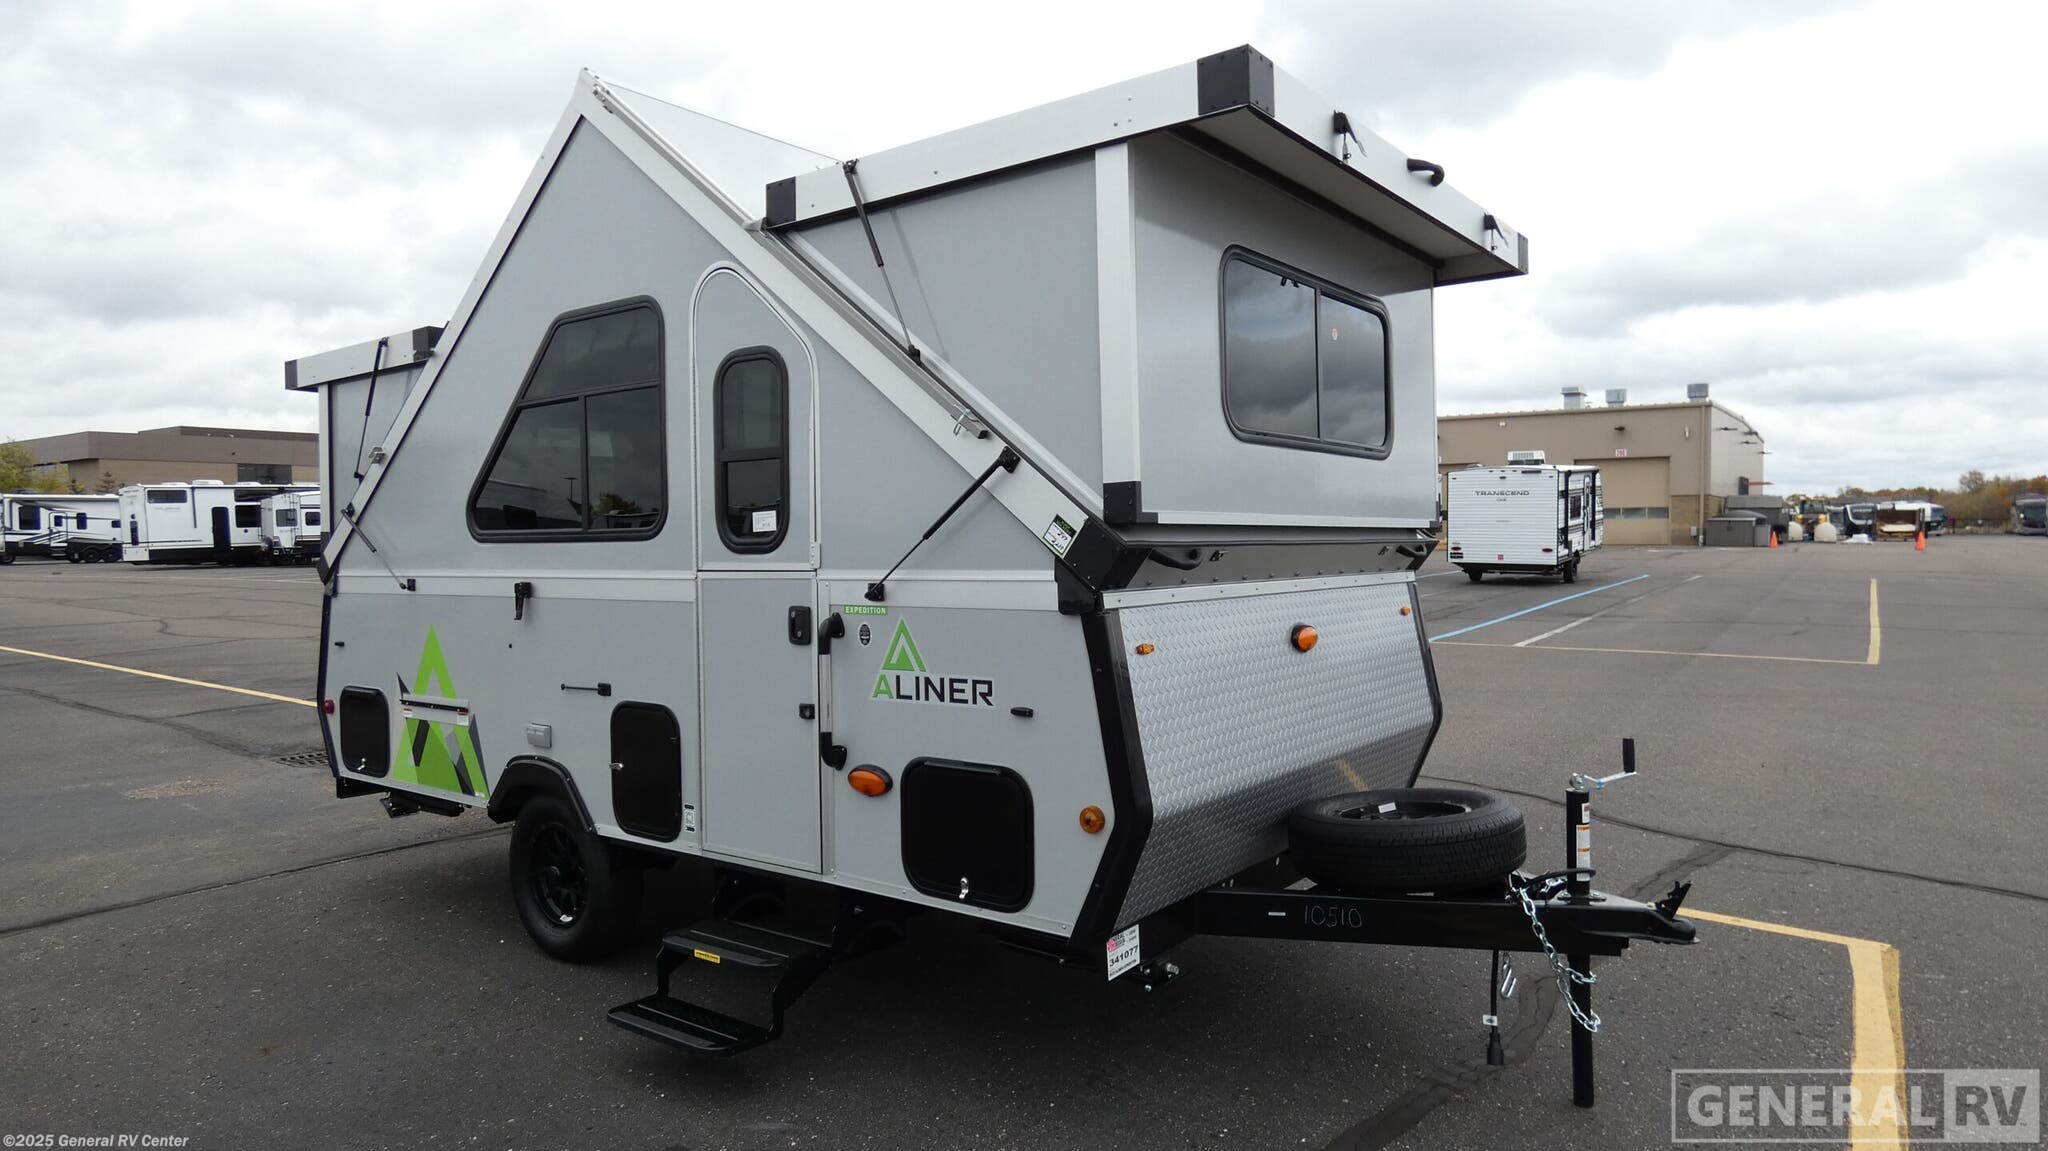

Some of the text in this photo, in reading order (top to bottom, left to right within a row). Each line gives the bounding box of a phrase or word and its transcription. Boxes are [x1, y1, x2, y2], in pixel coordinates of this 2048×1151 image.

[845, 606, 886, 615] EXPEDITION
[872, 673, 994, 706] ALINER
[1304, 905, 1362, 928] 10510
[1109, 944, 1139, 967] 341077
